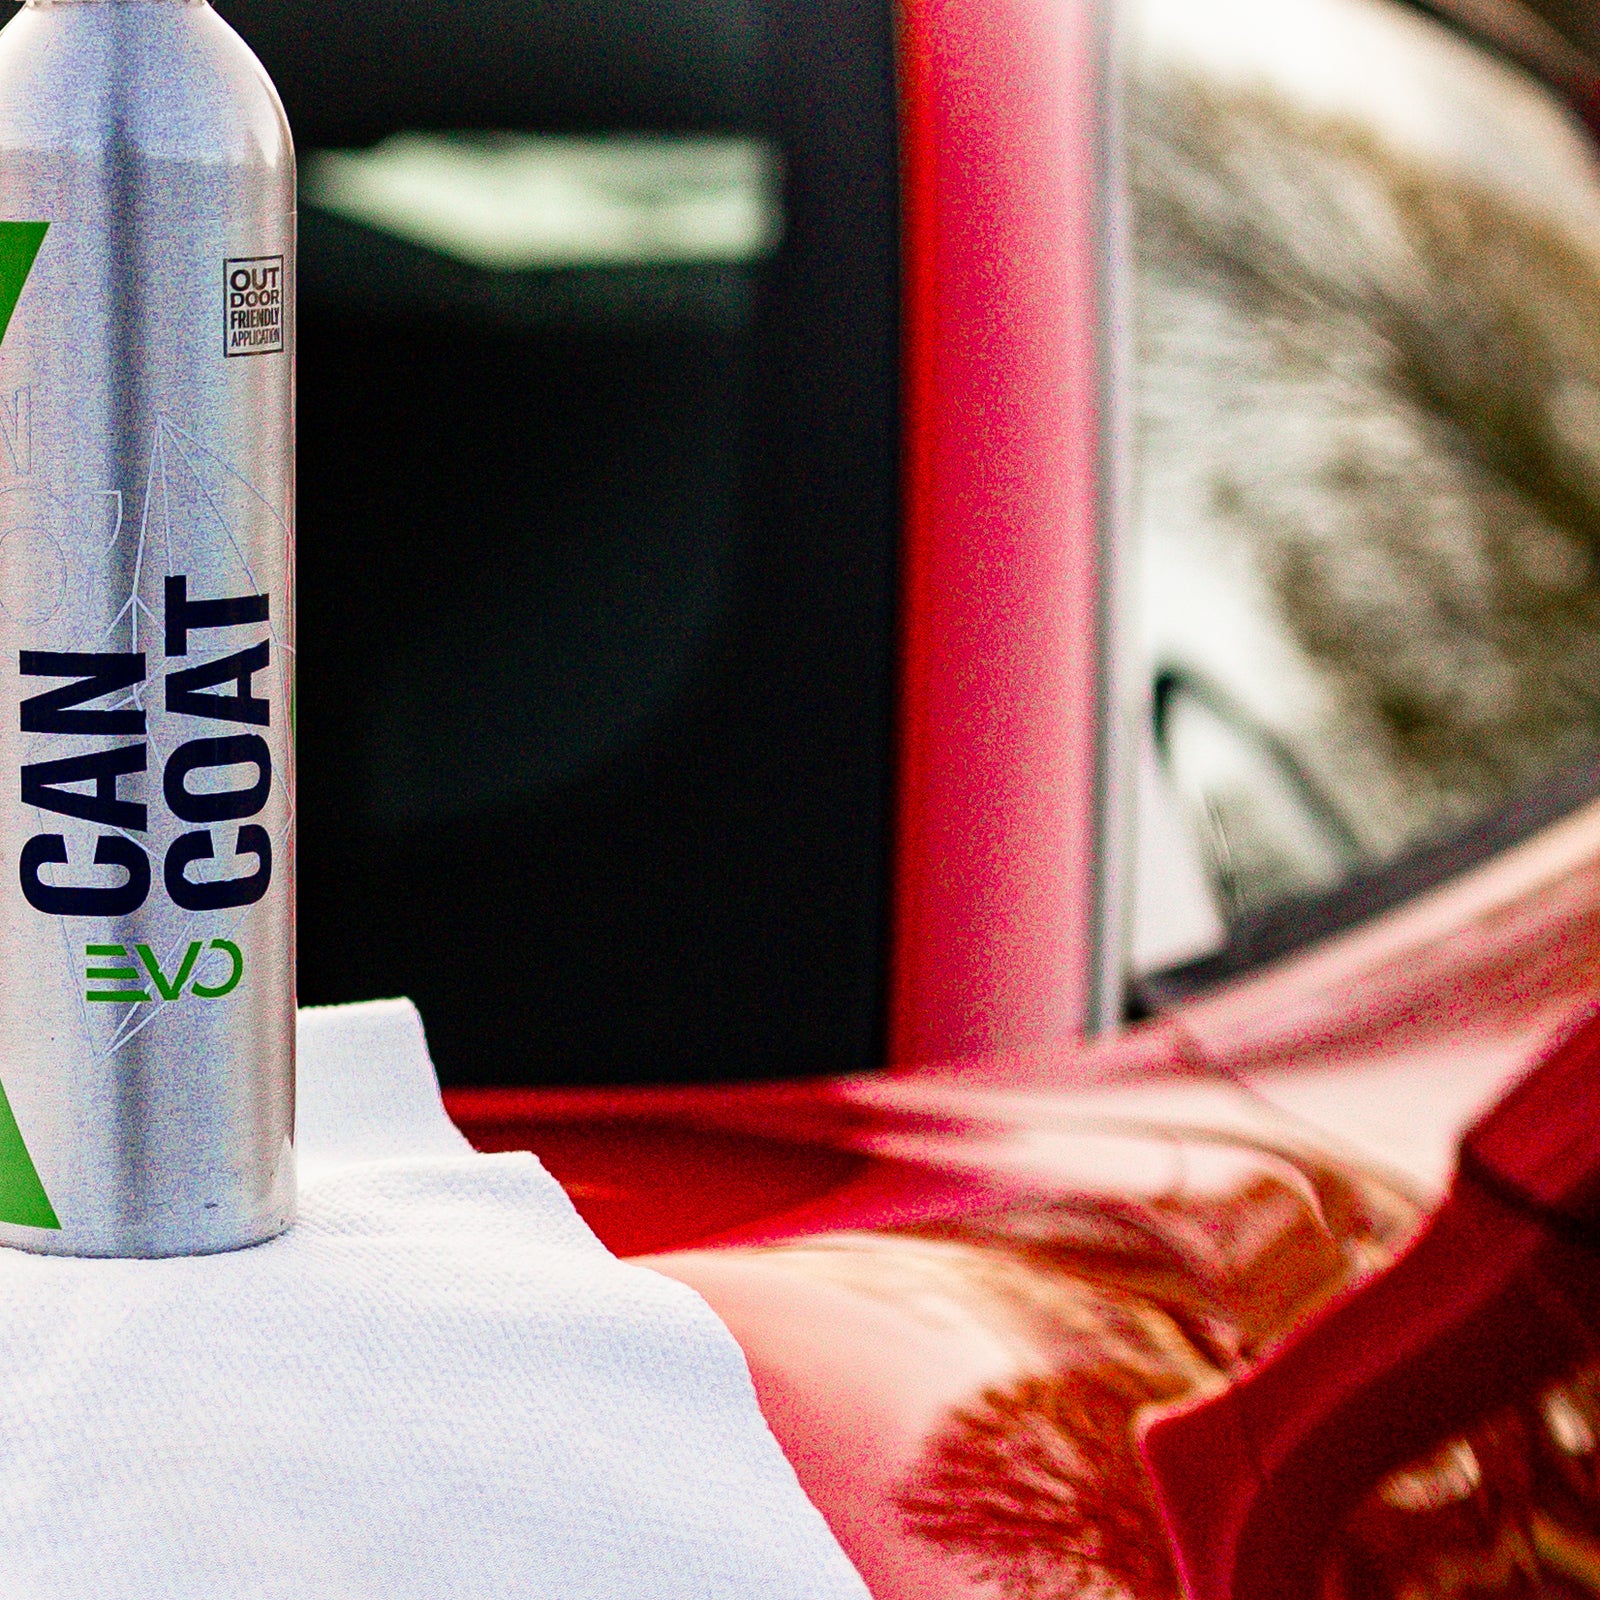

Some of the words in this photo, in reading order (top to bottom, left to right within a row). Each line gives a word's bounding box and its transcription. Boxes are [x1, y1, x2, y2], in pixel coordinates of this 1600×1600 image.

[230, 267, 279, 291] OUT
[230, 288, 279, 308] DOOR
[230, 307, 280, 330] FRIENDLY
[230, 328, 280, 347] APPLICATION
[163, 575, 272, 912] COAT
[19, 650, 151, 917] CAN
[86, 939, 243, 1002] EVO
